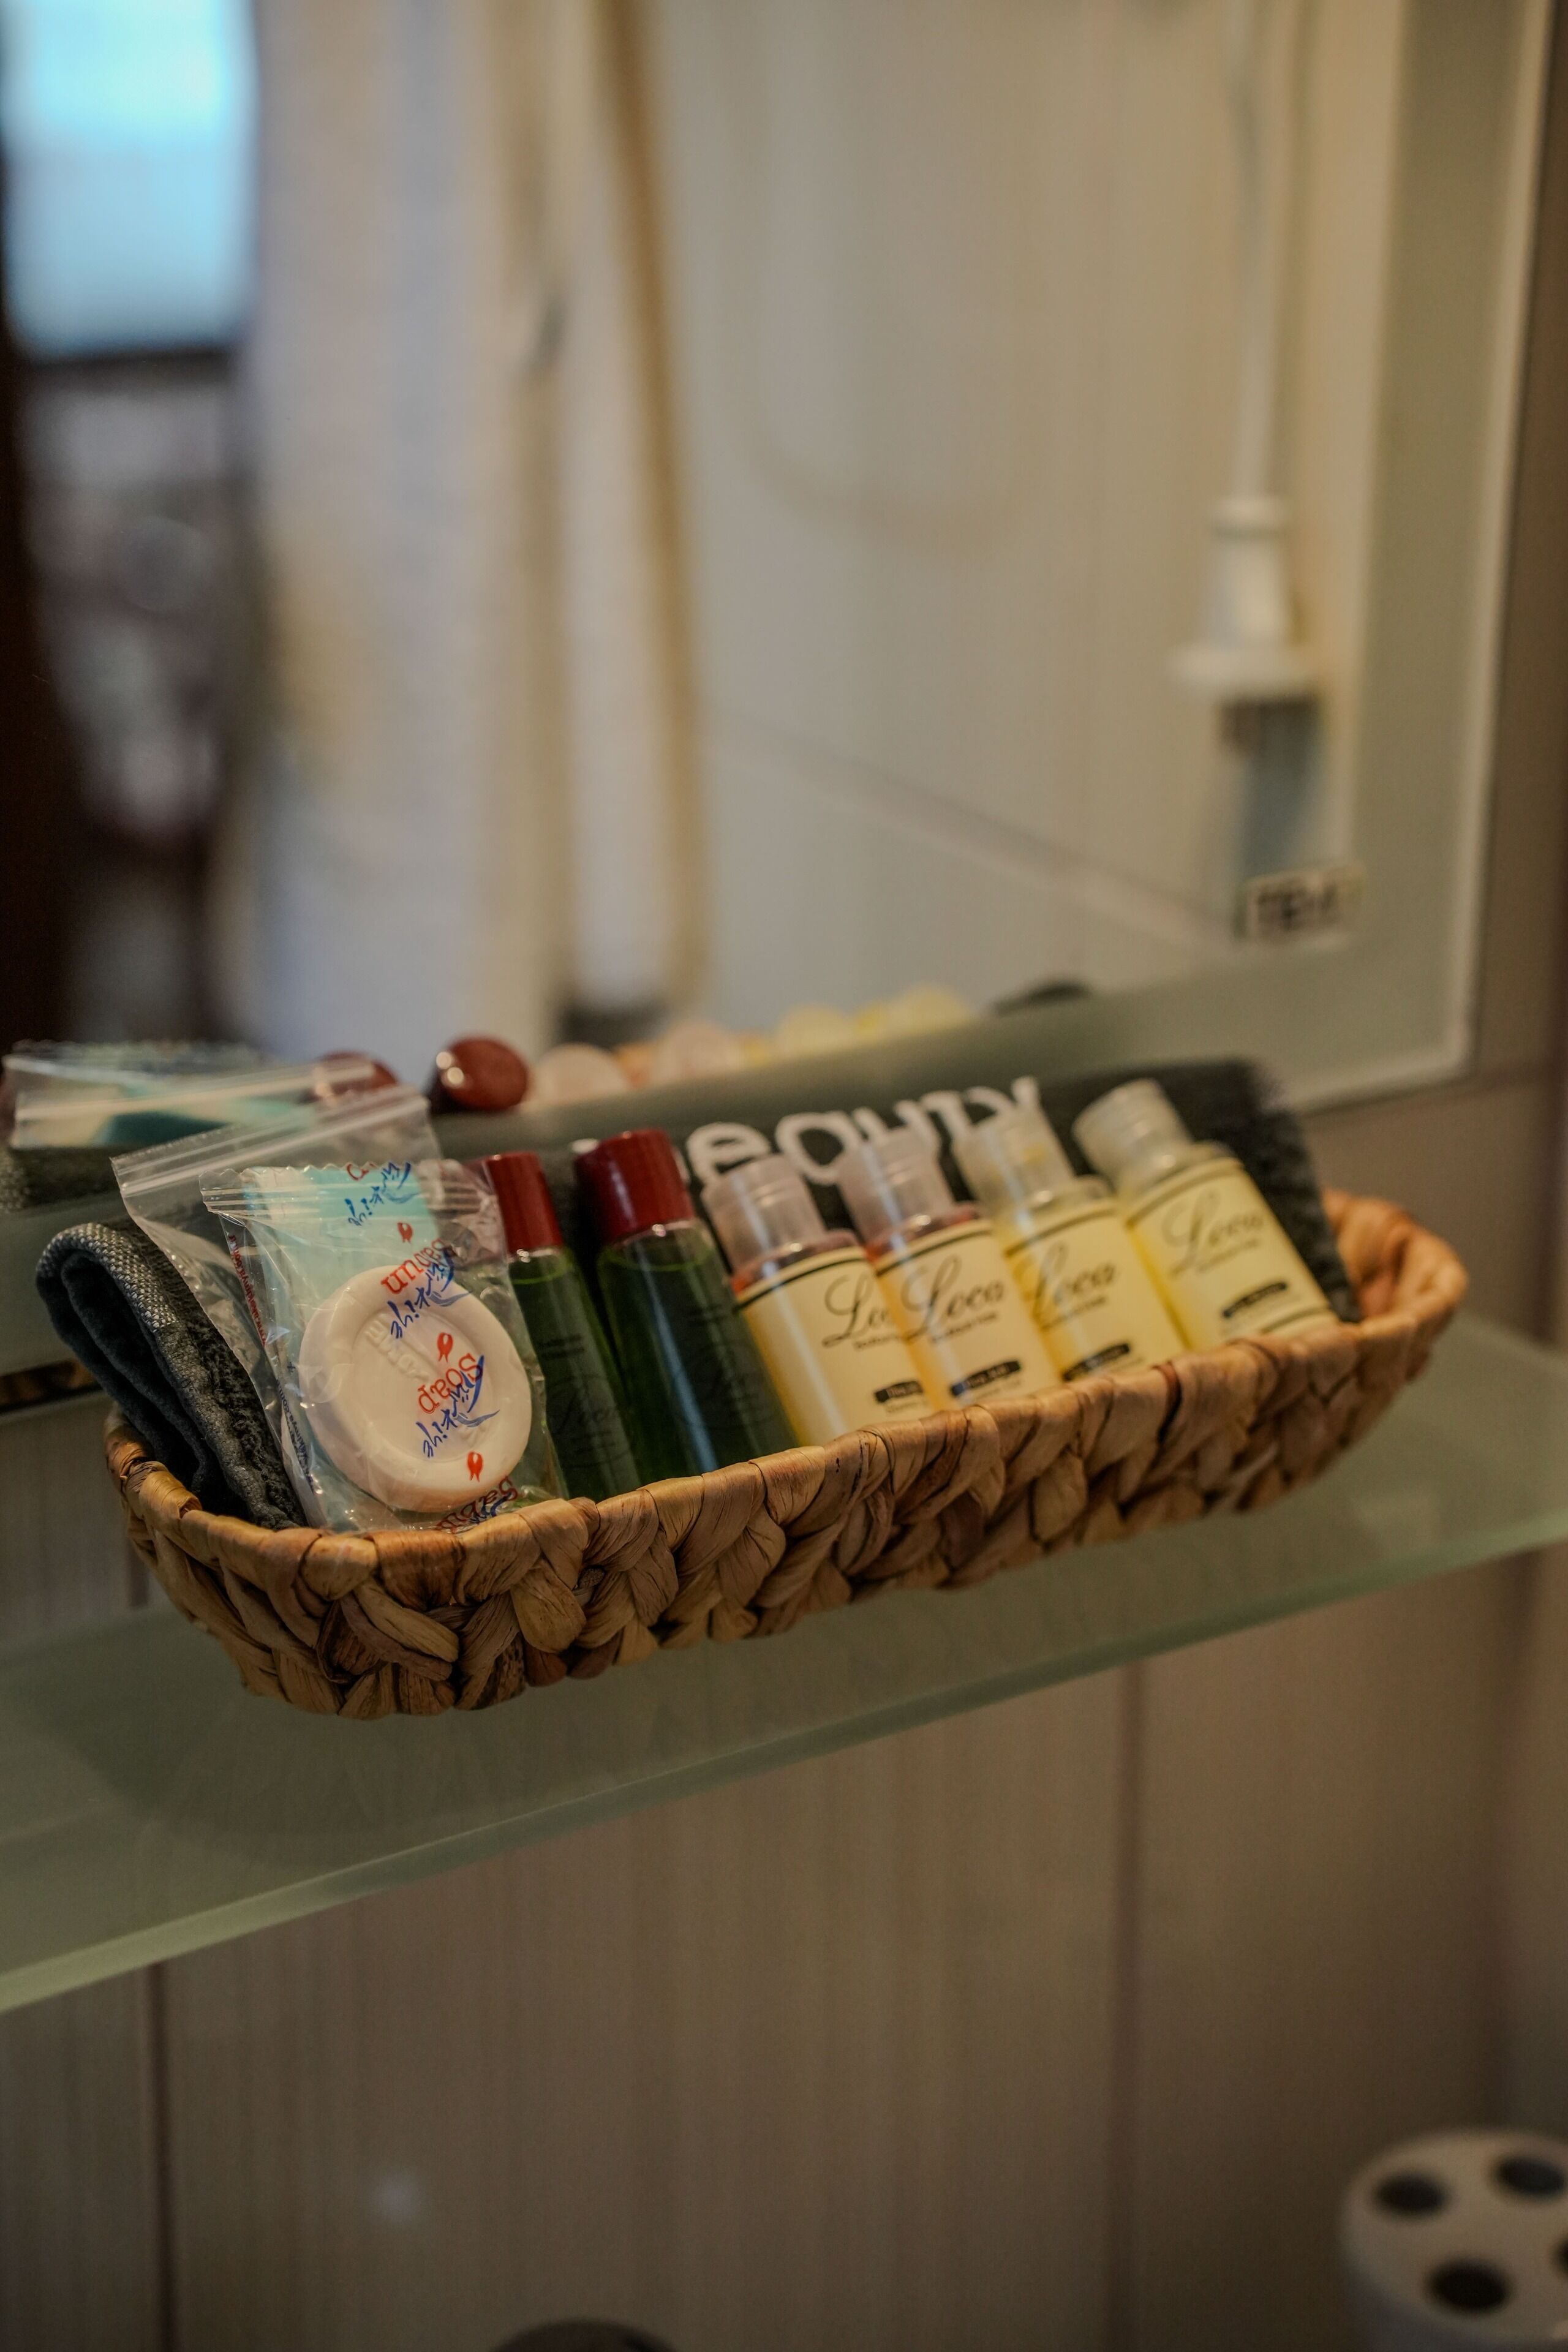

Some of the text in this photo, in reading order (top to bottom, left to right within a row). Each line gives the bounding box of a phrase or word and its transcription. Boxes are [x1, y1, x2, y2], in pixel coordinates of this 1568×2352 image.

[387, 1246, 462, 1339] Türkiye
[415, 1355, 486, 1458] Türkiye
[417, 1352, 483, 1414] Soap
